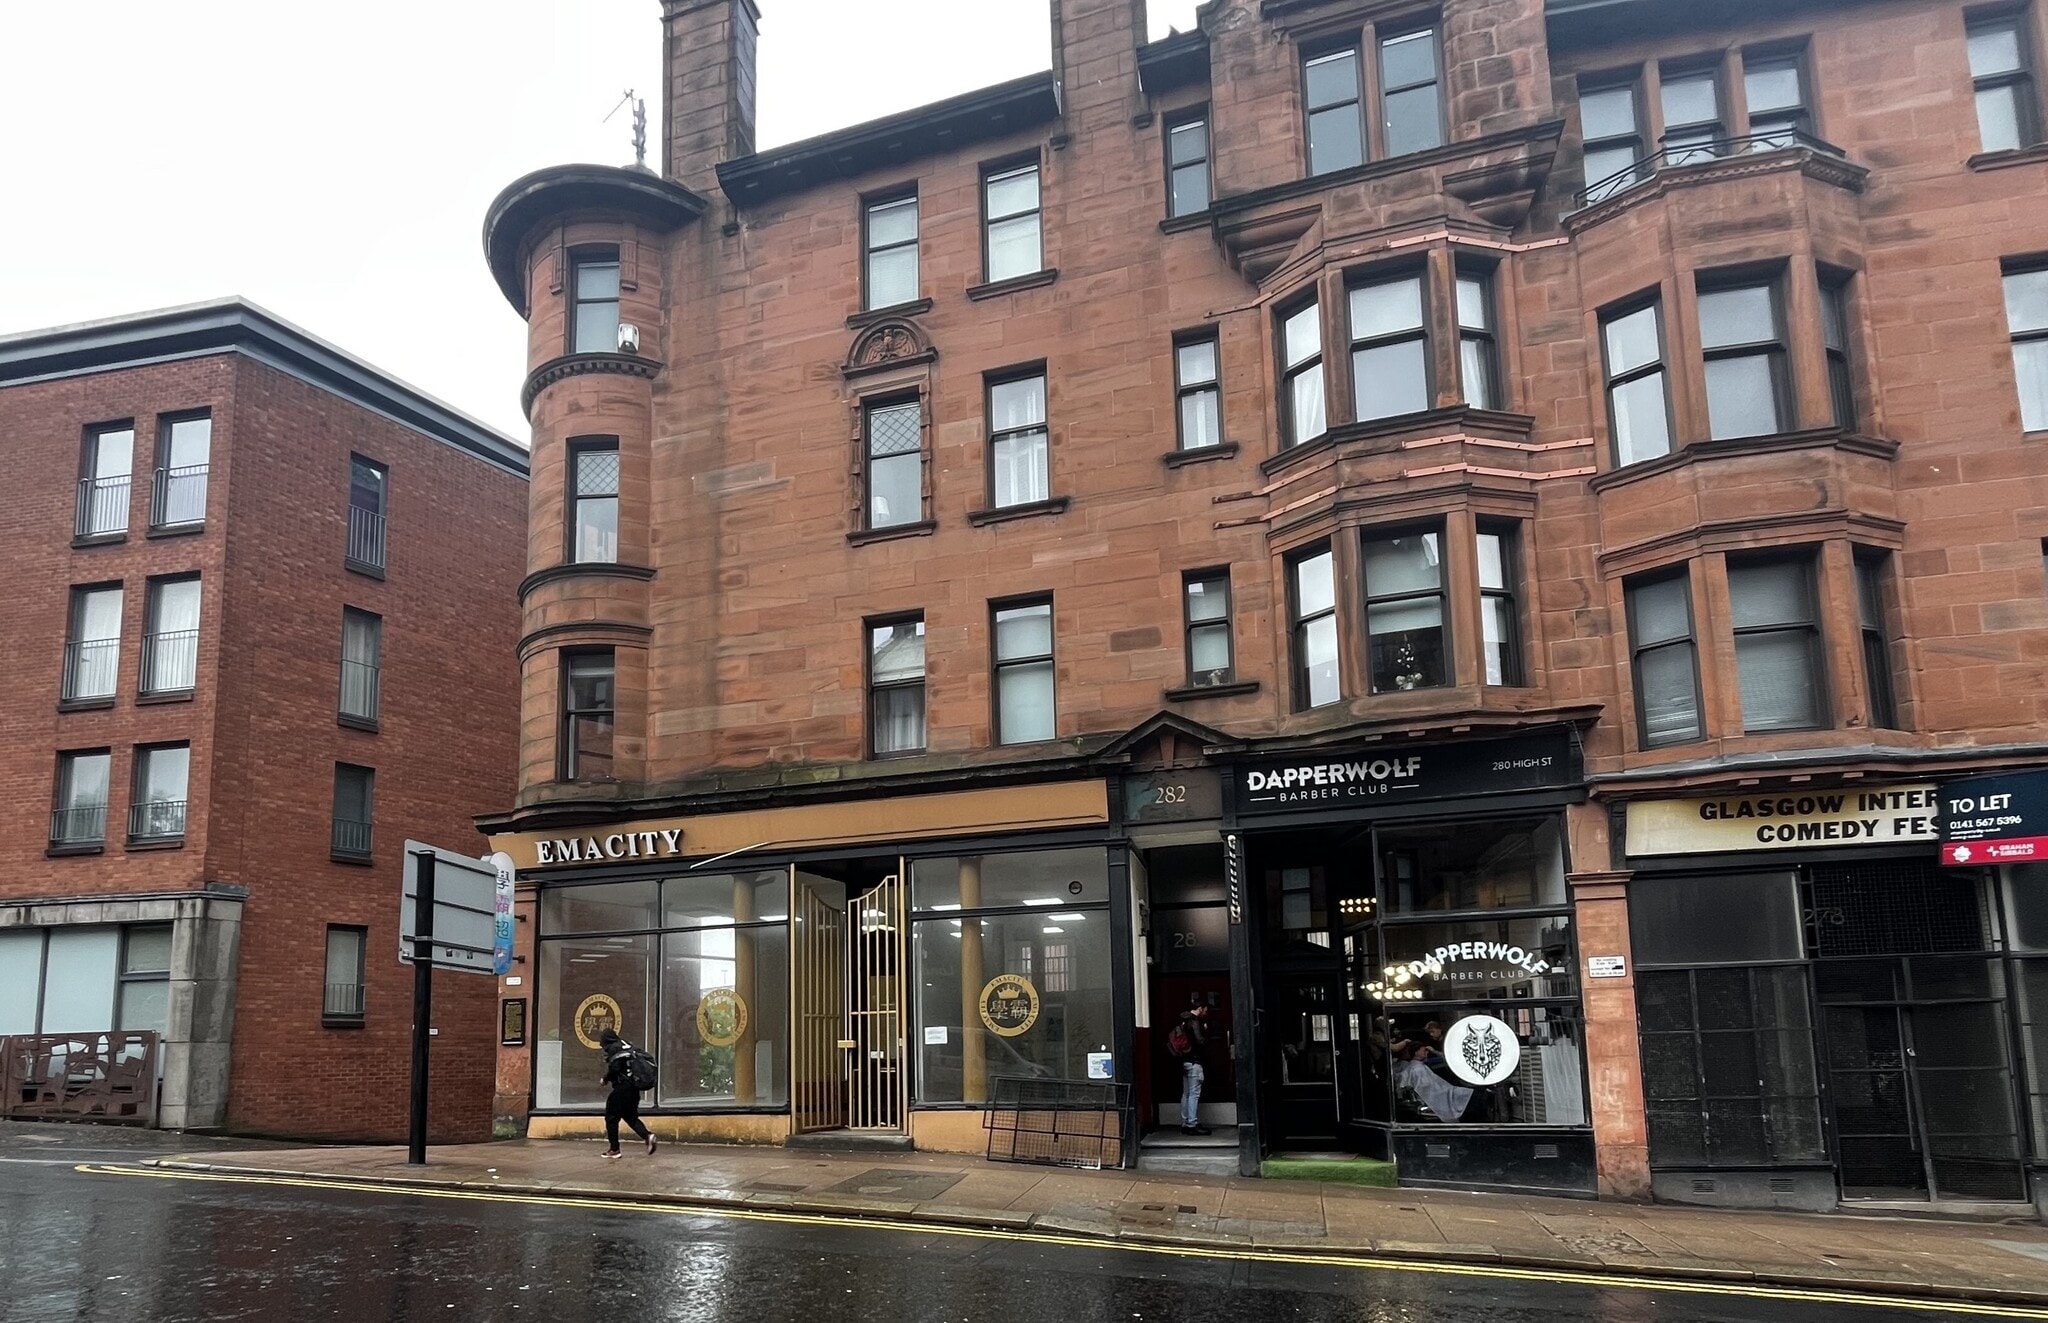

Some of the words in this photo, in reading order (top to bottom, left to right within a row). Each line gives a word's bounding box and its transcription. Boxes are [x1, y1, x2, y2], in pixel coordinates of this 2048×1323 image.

[1247, 756, 1422, 792] DAPPERWOLF
[1492, 761, 1511, 771] 280
[1513, 759, 1540, 768] HIGH
[1541, 756, 1553, 766] ST
[1155, 785, 1186, 804] 282
[1279, 788, 1339, 802] BARBER
[1347, 783, 1388, 796] CLUB
[1699, 794, 1845, 821] GLASGOW
[1949, 798, 1975, 814] TO
[1979, 793, 2012, 811] LET
[1756, 818, 1880, 843] COMEDY
[1949, 820, 1974, 829] 0141
[1975, 817, 1995, 828] 567
[1996, 815, 2023, 826] 5396
[534, 829, 682, 864] EMACITY
[1409, 941, 1550, 979] DAPPERWOLF
[1433, 972, 1484, 982] BARBER
[1490, 969, 1525, 979] CLUB
